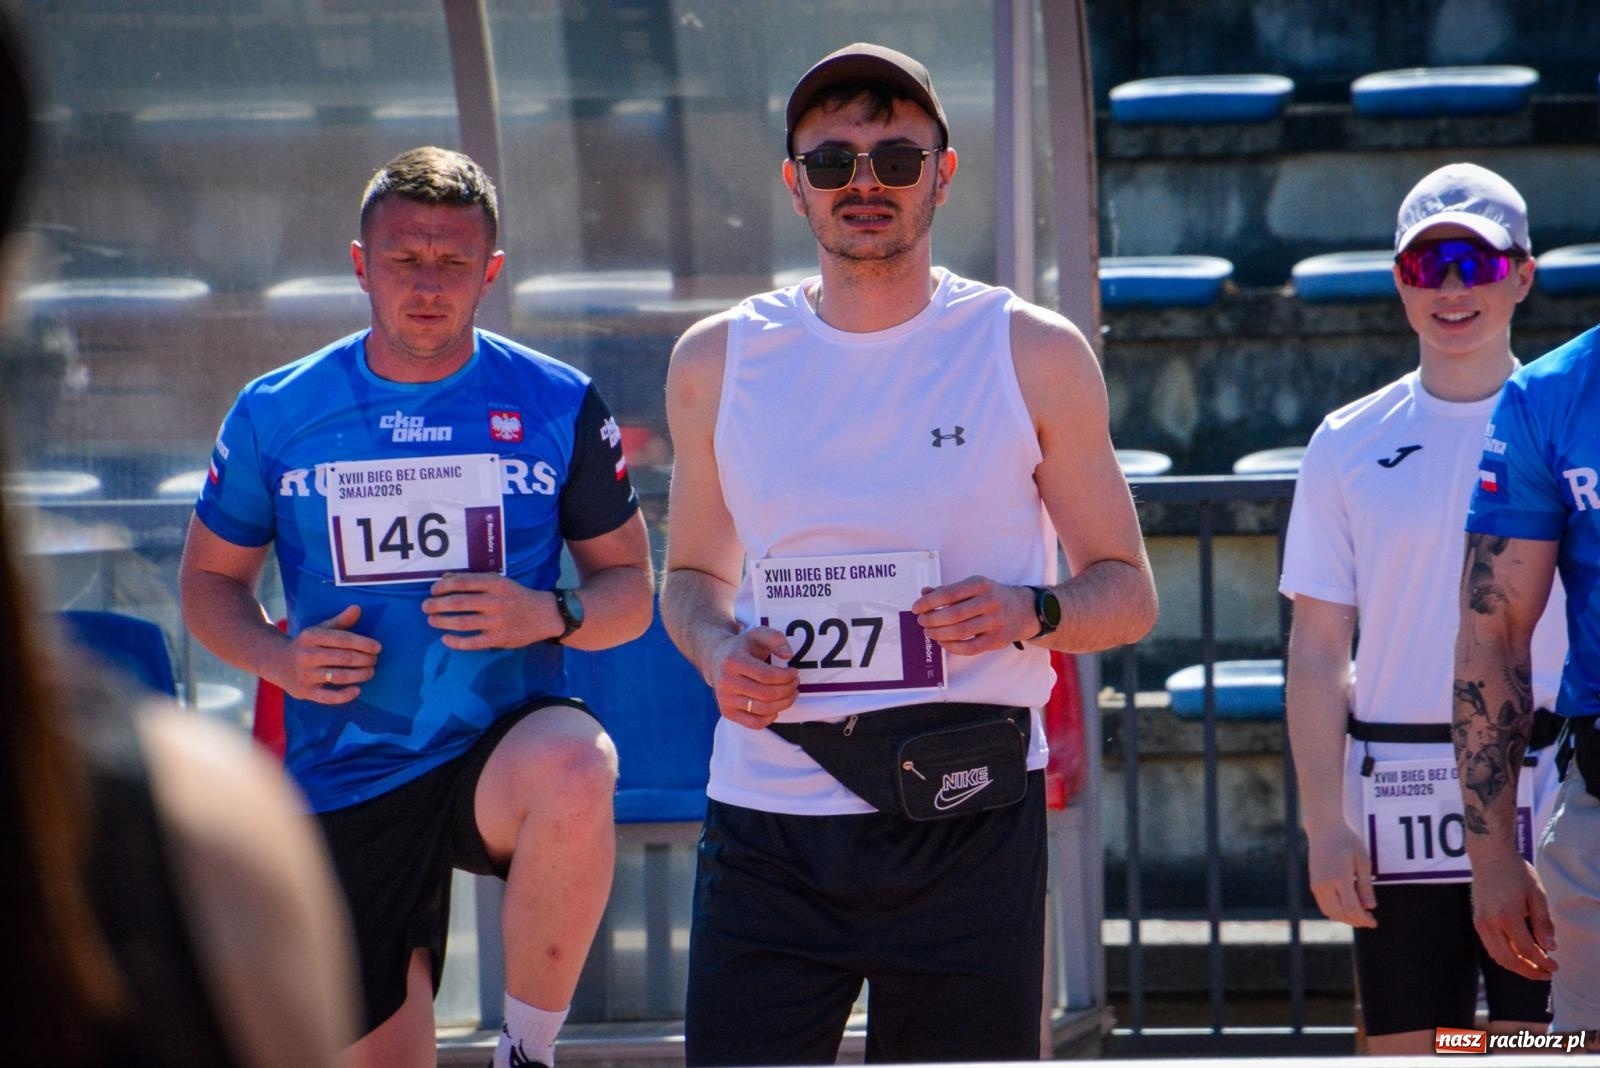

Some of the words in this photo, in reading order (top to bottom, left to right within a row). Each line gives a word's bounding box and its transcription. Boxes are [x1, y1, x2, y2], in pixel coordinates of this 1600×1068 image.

[338, 472, 364, 485] XVIII
[367, 470, 393, 483] BIEG
[396, 468, 416, 481] BEZ
[419, 466, 462, 480] GRANIC
[339, 484, 402, 499] 3MAJA2026
[356, 512, 450, 562] 146
[764, 569, 791, 583] XVIII
[795, 567, 821, 582] BIEG
[825, 566, 847, 580] BEZ
[850, 563, 897, 579] GRANIC
[766, 583, 832, 599] 3MAJA2026
[785, 617, 883, 669] 227
[942, 766, 989, 791] NIKE
[1401, 770, 1425, 782] BIEG
[1428, 768, 1448, 781] BEZ
[1374, 783, 1434, 798] 3MAJA2026
[1398, 812, 1467, 860] 110
